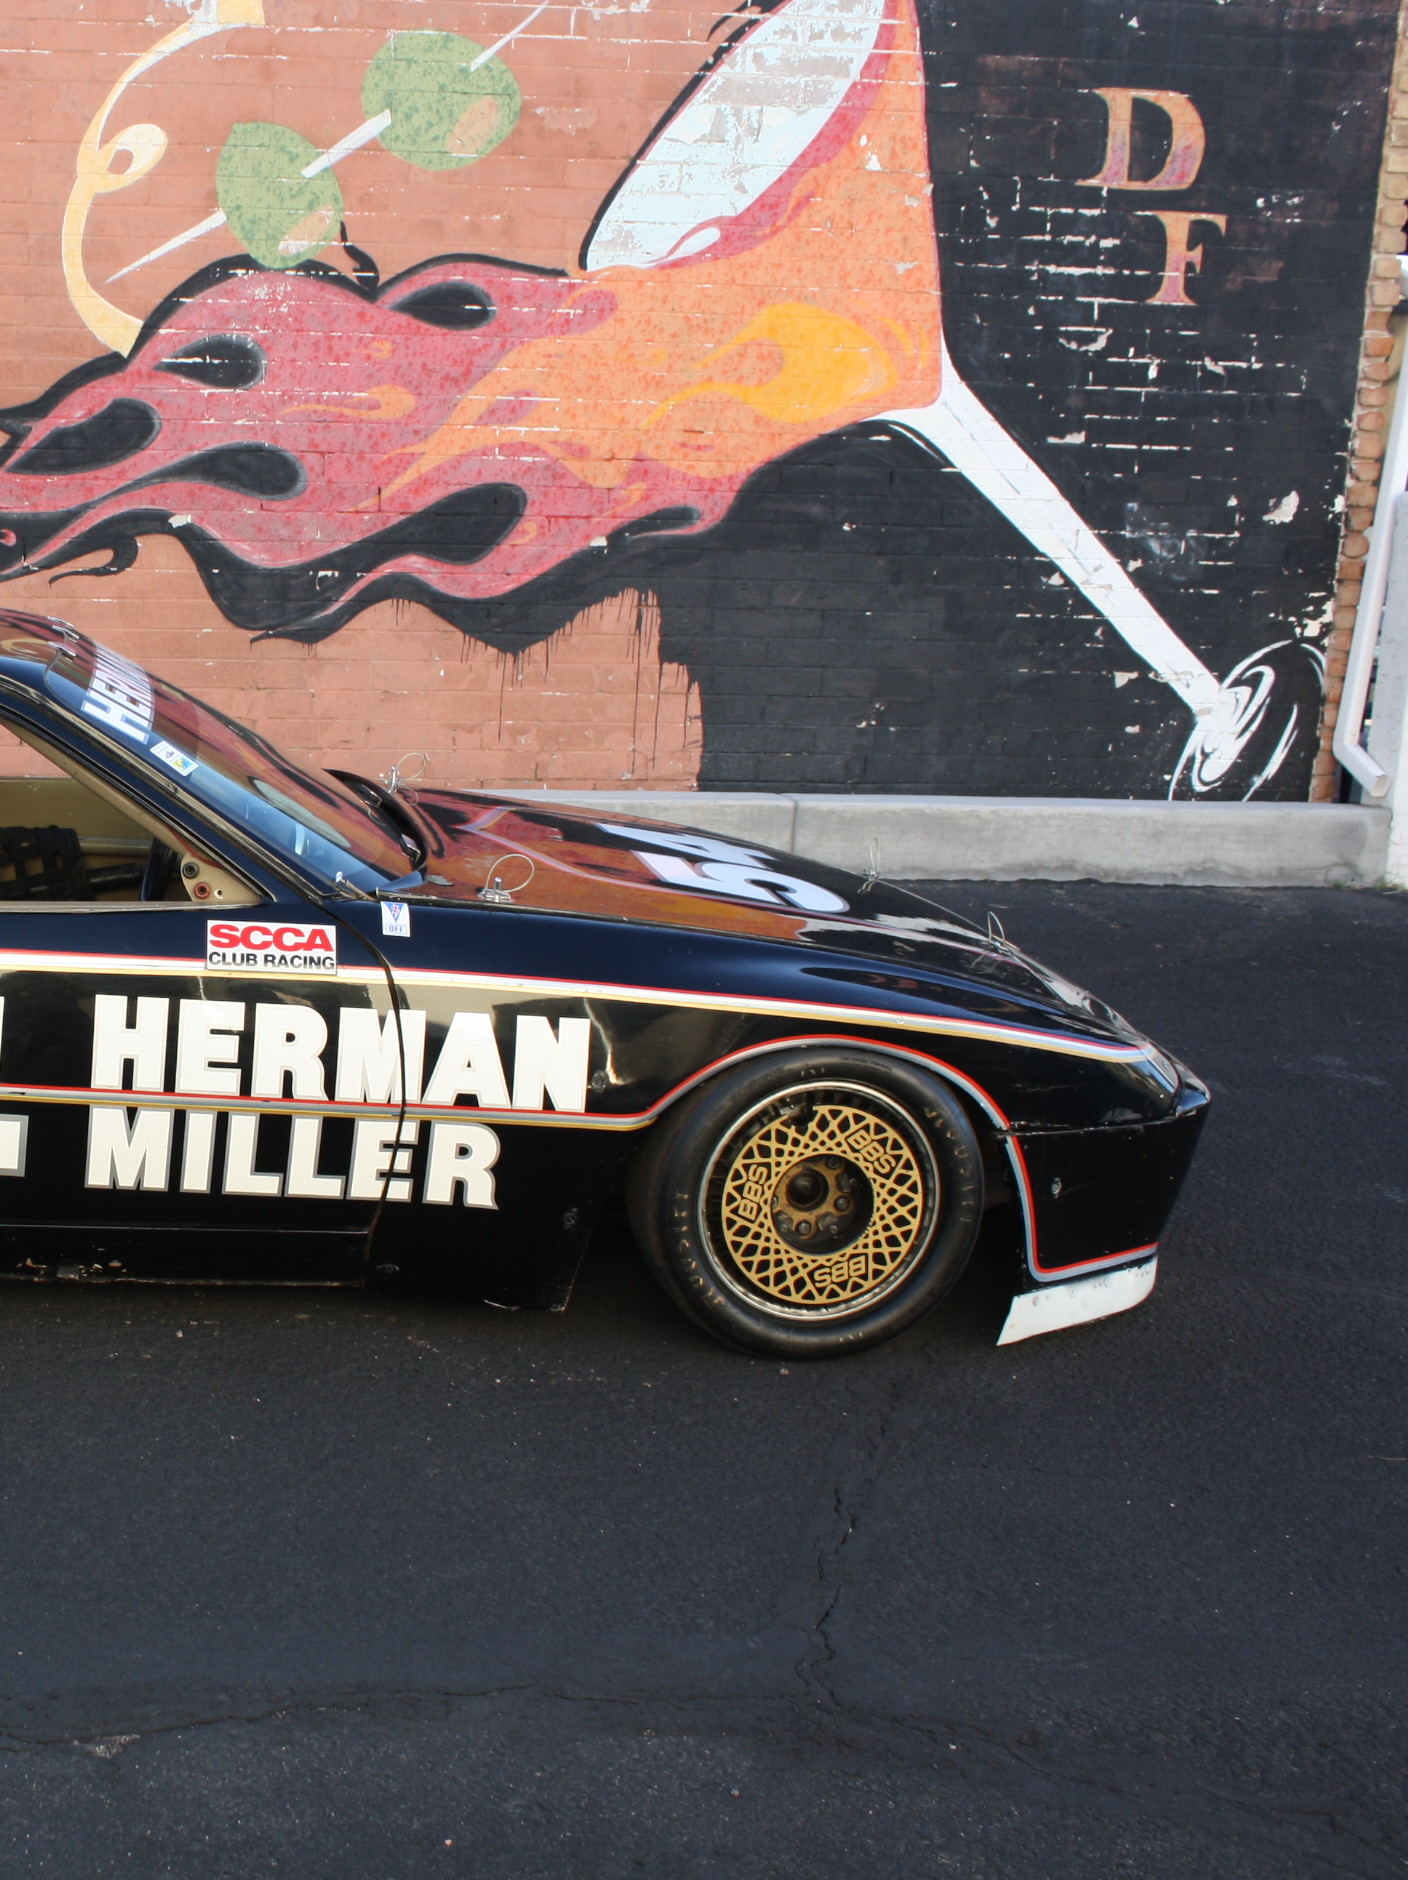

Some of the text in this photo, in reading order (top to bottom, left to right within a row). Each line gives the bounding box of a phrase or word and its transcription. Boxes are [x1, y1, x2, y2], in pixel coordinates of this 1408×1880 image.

[1075, 87, 1205, 190] D
[1146, 210, 1227, 305] F
[209, 924, 334, 952] SCCA
[389, 925, 405, 933] OFF
[208, 952, 335, 970] CLUB RACING
[91, 994, 591, 1113] HERMAN
[84, 1104, 500, 1211] MILLER
[845, 1128, 896, 1175] BBS
[738, 1163, 769, 1221] BBS
[813, 1255, 867, 1288] BBS
